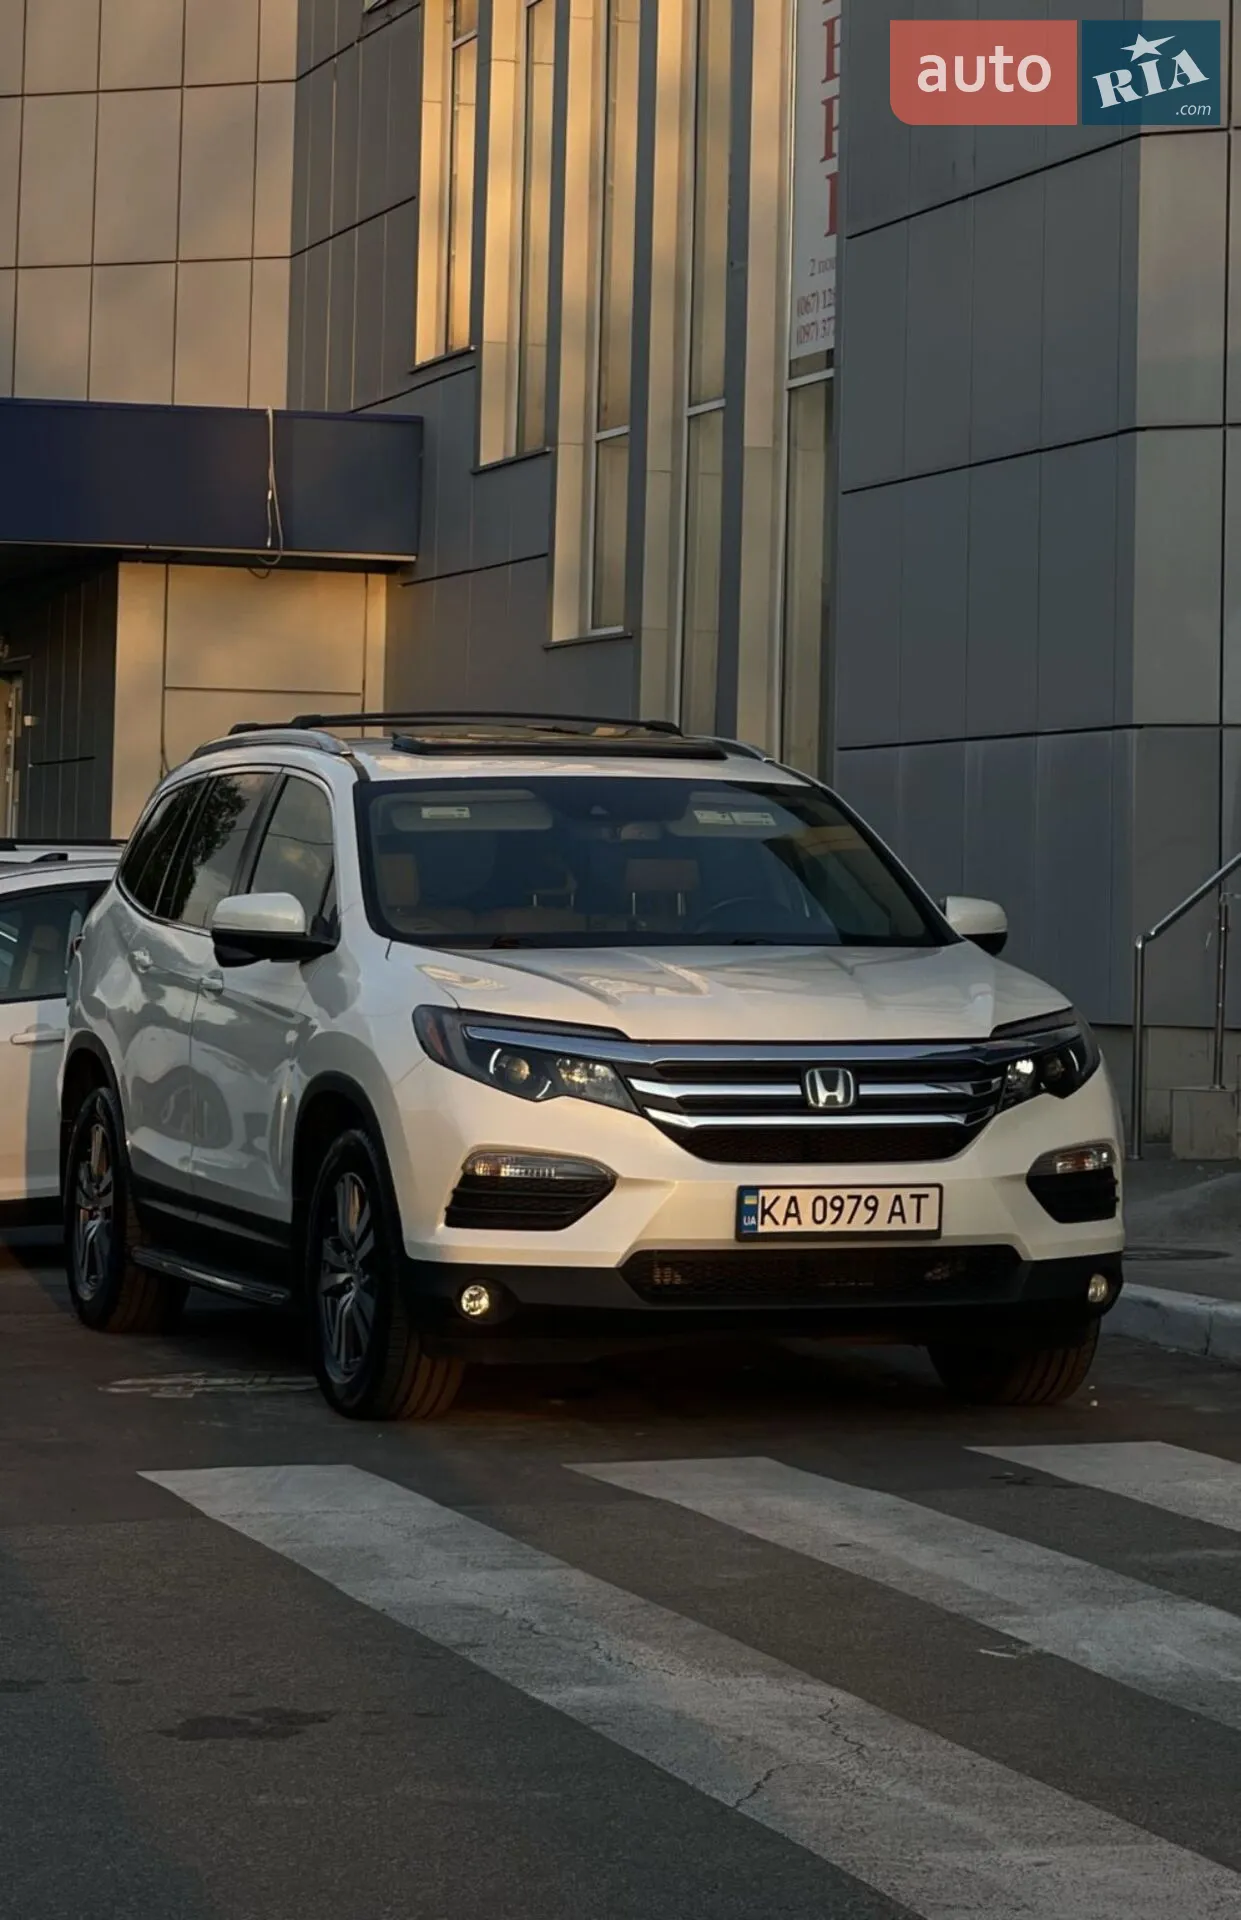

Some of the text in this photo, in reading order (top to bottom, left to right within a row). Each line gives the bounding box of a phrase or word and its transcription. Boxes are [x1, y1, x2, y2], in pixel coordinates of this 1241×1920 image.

[760, 1194, 930, 1226] KA 0979 AT
[743, 1216, 756, 1226] UA
